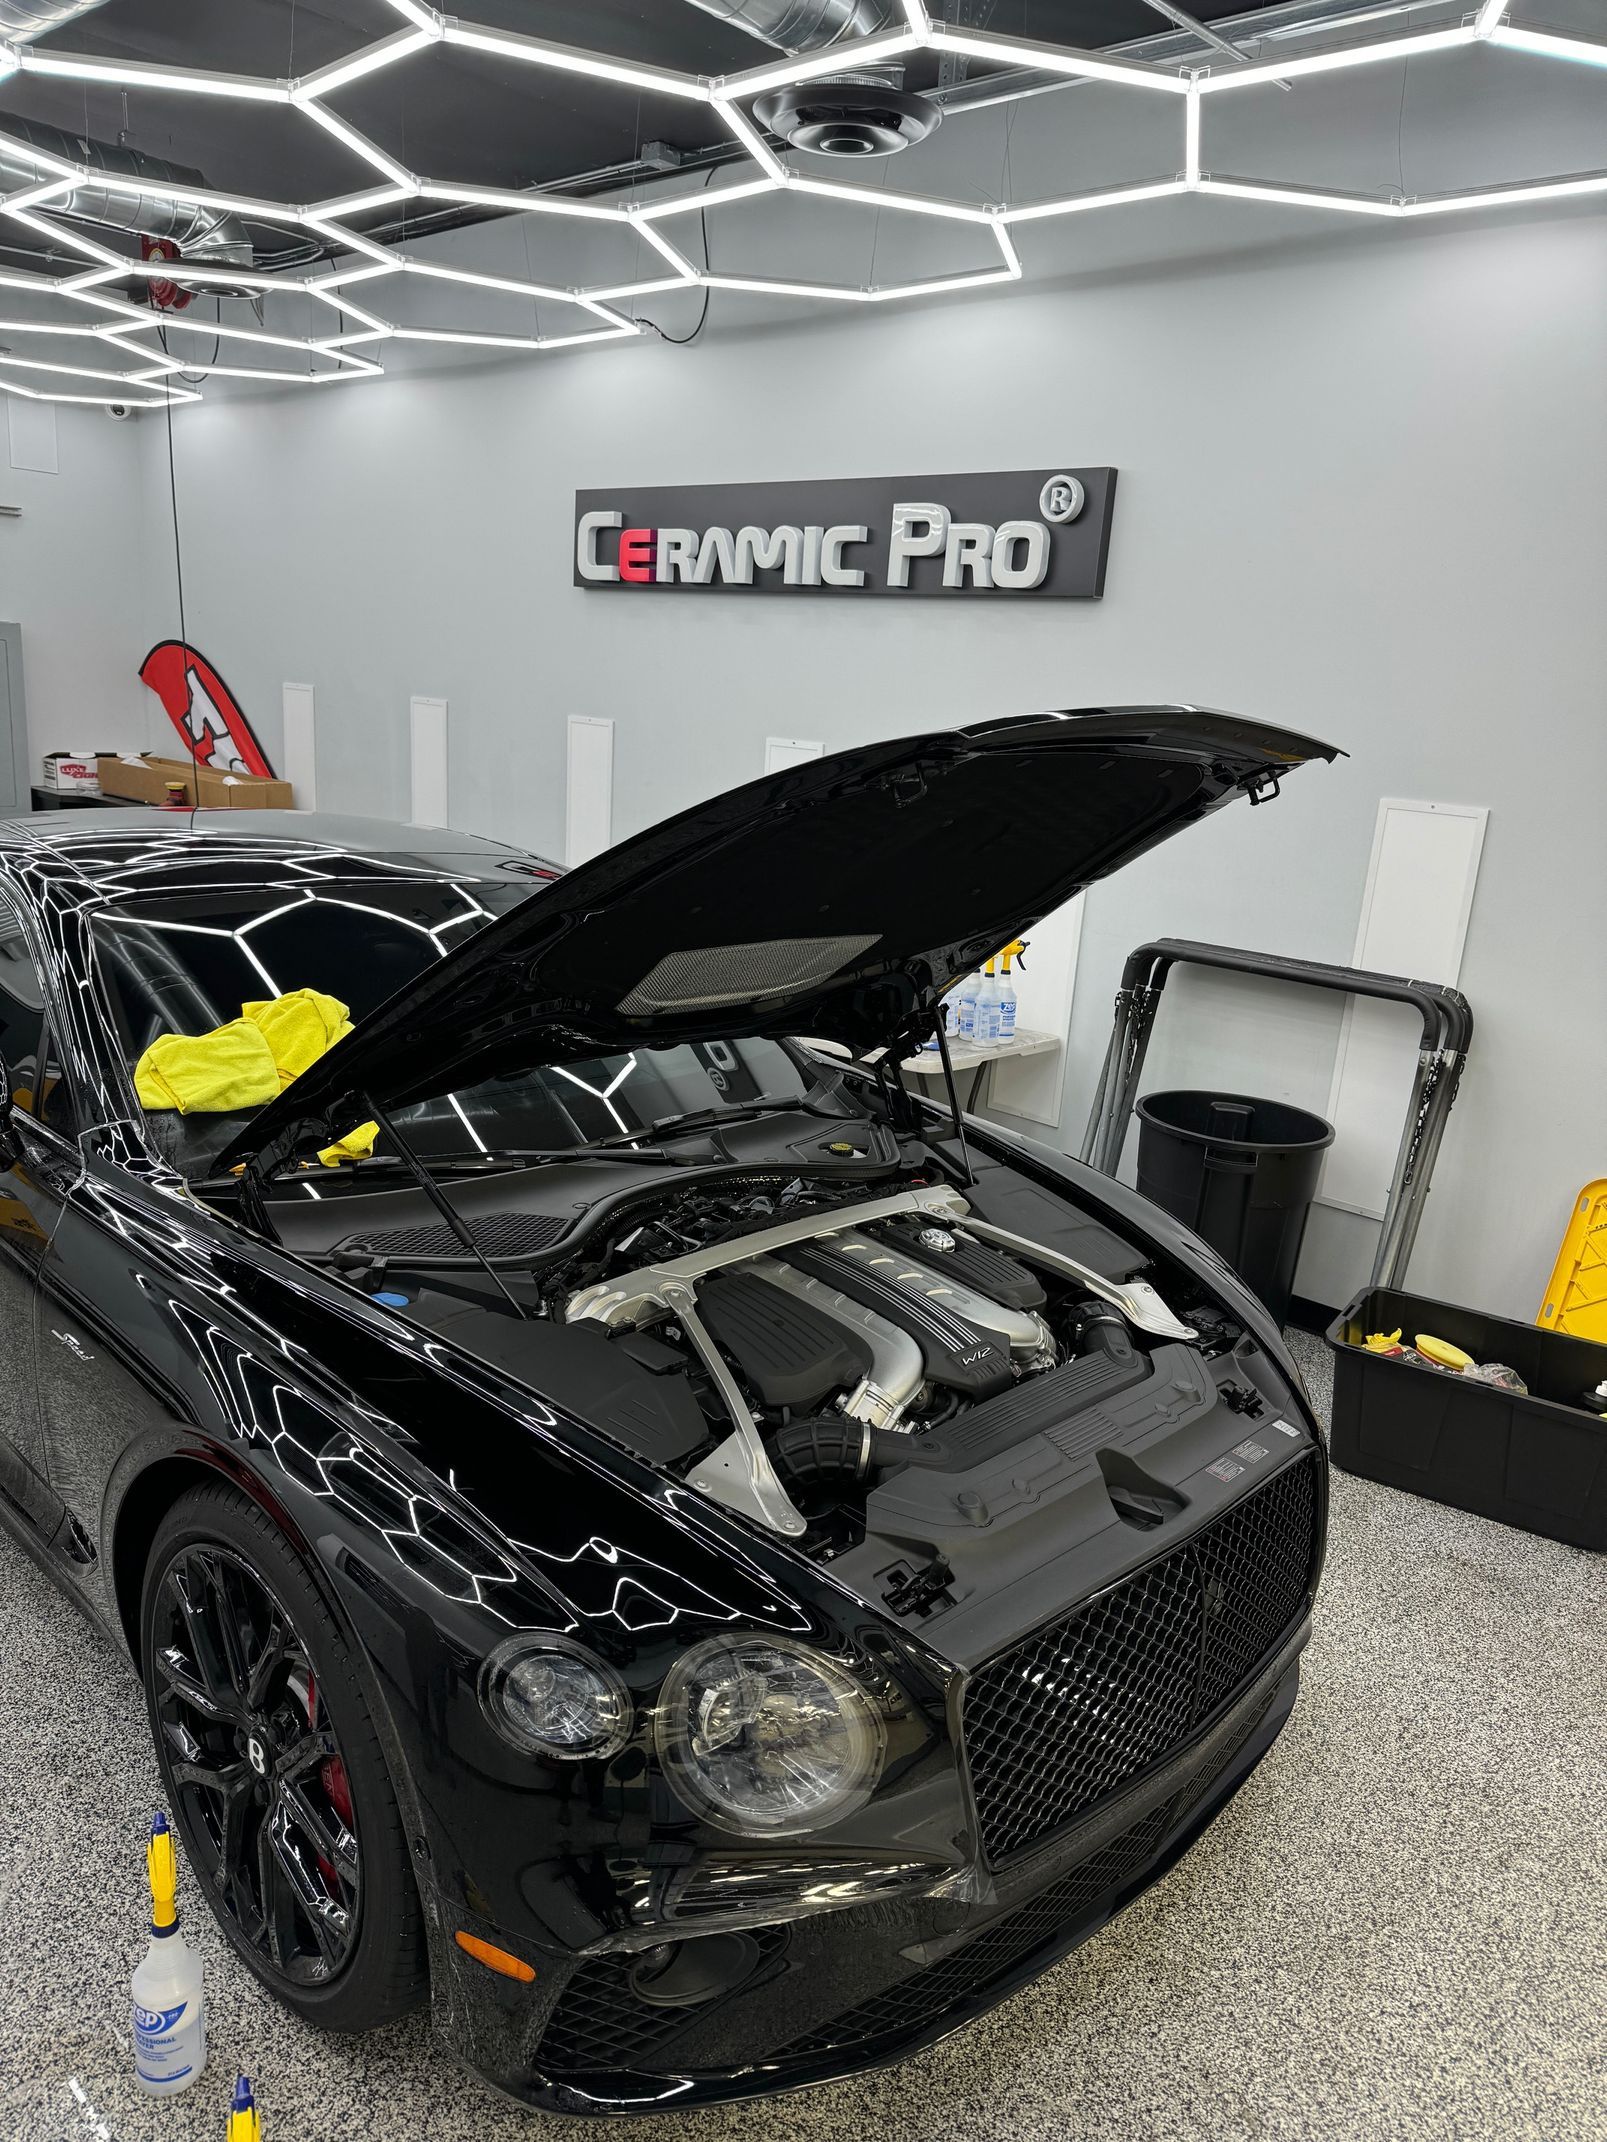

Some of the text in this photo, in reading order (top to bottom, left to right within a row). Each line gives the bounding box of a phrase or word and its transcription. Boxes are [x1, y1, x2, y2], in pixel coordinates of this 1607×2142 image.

[577, 511, 871, 587] CERAMIC
[962, 1347, 993, 1365] W12
[249, 1738, 265, 1774] B
[133, 2005, 158, 2028] ep
